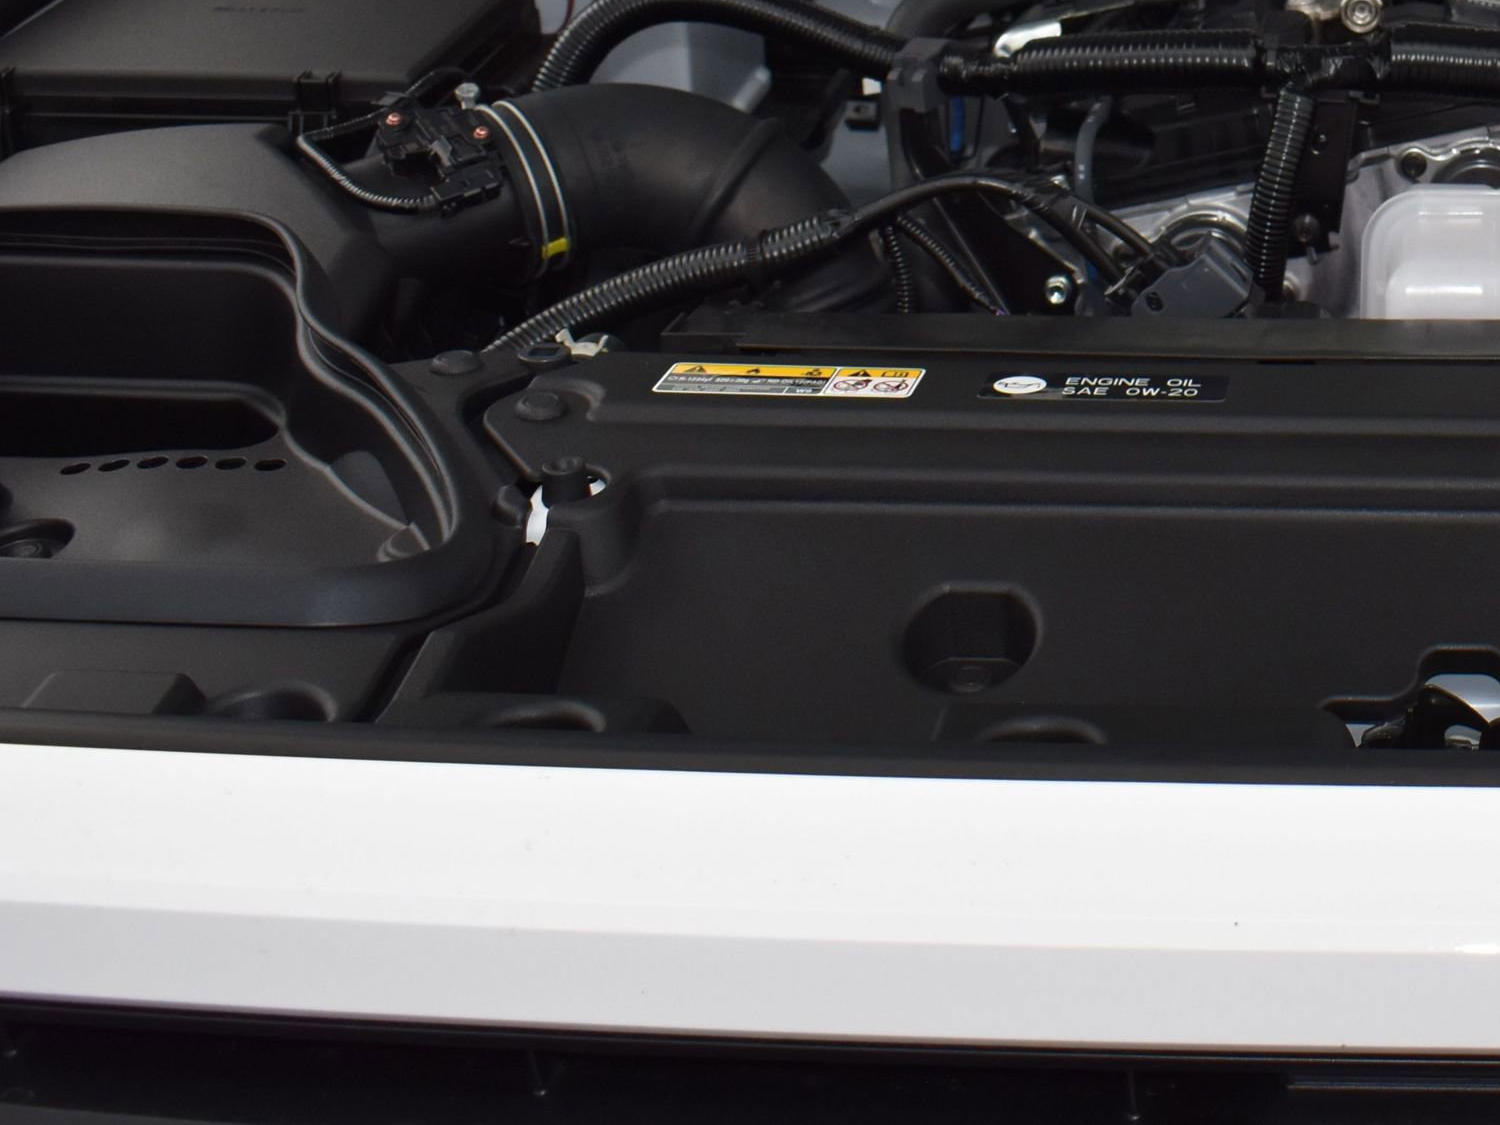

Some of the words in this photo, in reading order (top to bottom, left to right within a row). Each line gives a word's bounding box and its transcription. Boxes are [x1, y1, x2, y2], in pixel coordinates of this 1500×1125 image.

[1065, 377, 1151, 386] ENGINE
[1166, 378, 1202, 388] OIL
[1061, 386, 1110, 396] SAE
[1125, 387, 1199, 397] 0W-20
